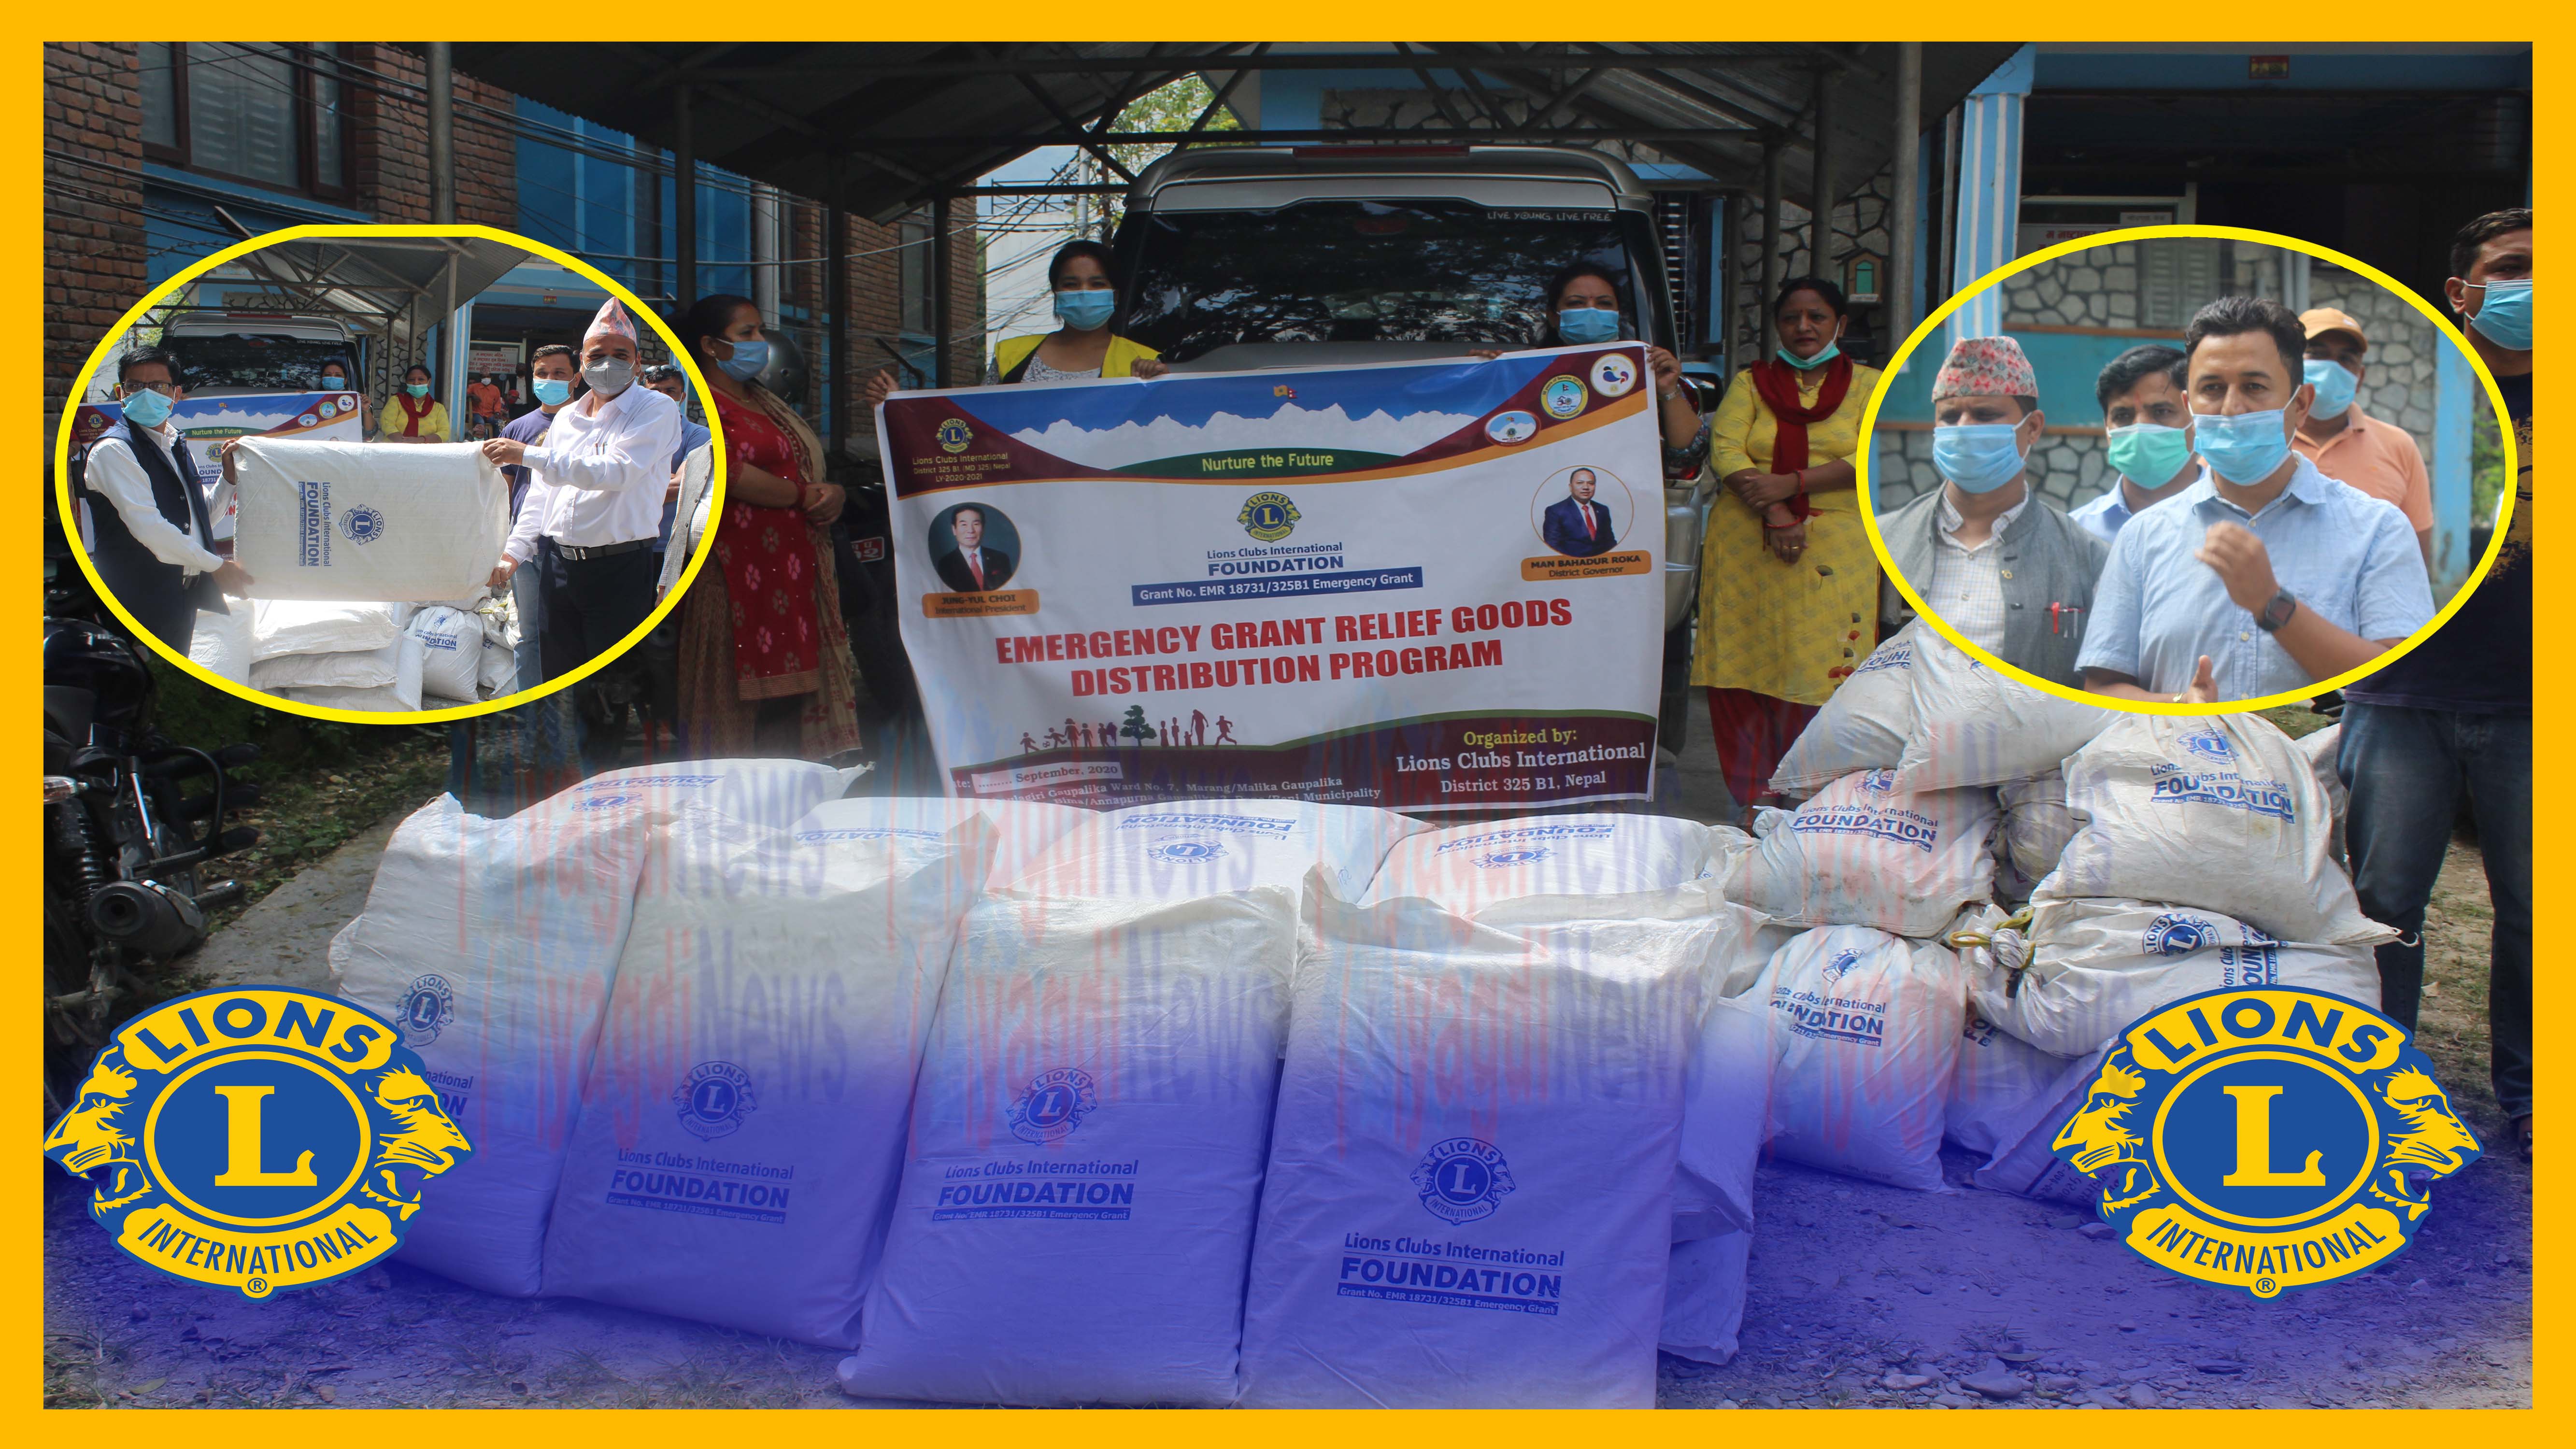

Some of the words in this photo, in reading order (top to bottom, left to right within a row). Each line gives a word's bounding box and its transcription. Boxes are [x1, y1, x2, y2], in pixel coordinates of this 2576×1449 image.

[1557, 213, 1580, 221] LIVE
[1583, 213, 1611, 221] FREE
[960, 453, 1008, 462] International
[994, 463, 1010, 471] Nepal
[1202, 454, 1257, 472] Nurture
[1261, 453, 1284, 468] the
[1287, 453, 1334, 468] Future
[322, 483, 331, 500] Lions
[1251, 494, 1286, 505] LIONS
[323, 502, 331, 520] Clubs
[307, 482, 319, 567] FOUNDATION
[373, 513, 382, 537] LIONS
[1207, 550, 1236, 559] Lions
[1238, 546, 1267, 557] Clubs
[1270, 542, 1342, 555] International
[1208, 555, 1343, 576] FOUNDATION
[1531, 560, 1554, 568] MAN
[1558, 557, 1608, 567] BAHADUR
[1612, 555, 1641, 563] ROKA
[1549, 568, 1580, 577] District
[1583, 567, 1623, 575] Governor
[1140, 590, 1173, 600] Grant
[1177, 587, 1196, 598] No.
[1200, 585, 1225, 596] EMR
[1229, 580, 1309, 595] 18731/325B1
[1312, 577, 1377, 589] Emergency
[1380, 573, 1413, 584] Grant
[942, 596, 986, 604] JUNG-YUL
[995, 625, 1201, 664] EMERGENCY
[1211, 618, 1325, 650] GRANT
[1334, 609, 1442, 642] RELIEF
[1452, 598, 1572, 633] GOODS
[1071, 654, 1320, 696] DISTRIBUTION
[1329, 639, 1503, 679] PROGRAM
[1464, 729, 1547, 749] Organized
[1552, 728, 1577, 745] by:
[1396, 754, 1451, 772] Lions
[1458, 752, 1511, 769] Clubs
[1517, 742, 1646, 767] International
[956, 779, 970, 788] te:
[1048, 785, 1107, 797] Gaupalika
[1186, 783, 1278, 794] Marang/Malika
[1281, 778, 1343, 791] Gaupalika
[1441, 779, 1499, 793] District
[1504, 778, 1531, 791] 325
[1536, 777, 1561, 790] B1,
[1565, 771, 1606, 789] Nepal
[1304, 789, 1381, 802] Municipality
[1802, 806, 1829, 814] Lions
[1832, 804, 1861, 812] Clubs
[1116, 822, 1206, 830] International
[1122, 816, 1293, 832] FOUNDATION
[1793, 815, 1936, 842] FOUNDATION
[1437, 827, 1614, 852] FOUNDATION
[2147, 919, 2168, 953] LIONS
[416, 977, 451, 995] LIONS
[1859, 1038, 1880, 1046] Grant
[692, 1064, 746, 1083] LIONS
[1035, 1069, 1090, 1091] LIONS
[704, 1086, 726, 1113] L
[1038, 1091, 1061, 1117] L
[686, 1112, 735, 1136] INTERNATIONAL
[1017, 1124, 1069, 1139] INTERNATIONAL
[1436, 1140, 1498, 1162] LIONS
[619, 1148, 652, 1164] Lions
[655, 1151, 693, 1169] Clubs
[697, 1156, 794, 1179] International
[945, 1165, 980, 1179] Lions
[983, 1161, 1024, 1176] Clubs
[1027, 1160, 1139, 1175] International
[610, 1169, 790, 1208] FOUNDATION
[1450, 1163, 1477, 1194] L
[938, 1182, 1135, 1206] FOUNDATION
[630, 1198, 643, 1206] No.
[716, 1209, 759, 1221] Emergency
[761, 1213, 784, 1223] Grant
[990, 1210, 1047, 1219] 18731/325B1
[1050, 1211, 1098, 1220] Emergency
[1101, 1210, 1127, 1220] Grant
[1429, 1198, 1489, 1218] INTERNATIONAL
[1344, 1233, 1391, 1251] Lions
[1395, 1237, 1442, 1255] Clubs
[1446, 1242, 1565, 1266] International
[1340, 1257, 1562, 1298] FOUNDATION
[1340, 1287, 1366, 1297] Grant
[1367, 1289, 1383, 1299] No.
[1386, 1292, 1406, 1300] EMR
[1409, 1293, 1472, 1307] 18731/325B1
[1475, 1299, 1525, 1312] Emergency
[1528, 1304, 1555, 1314] Grant
